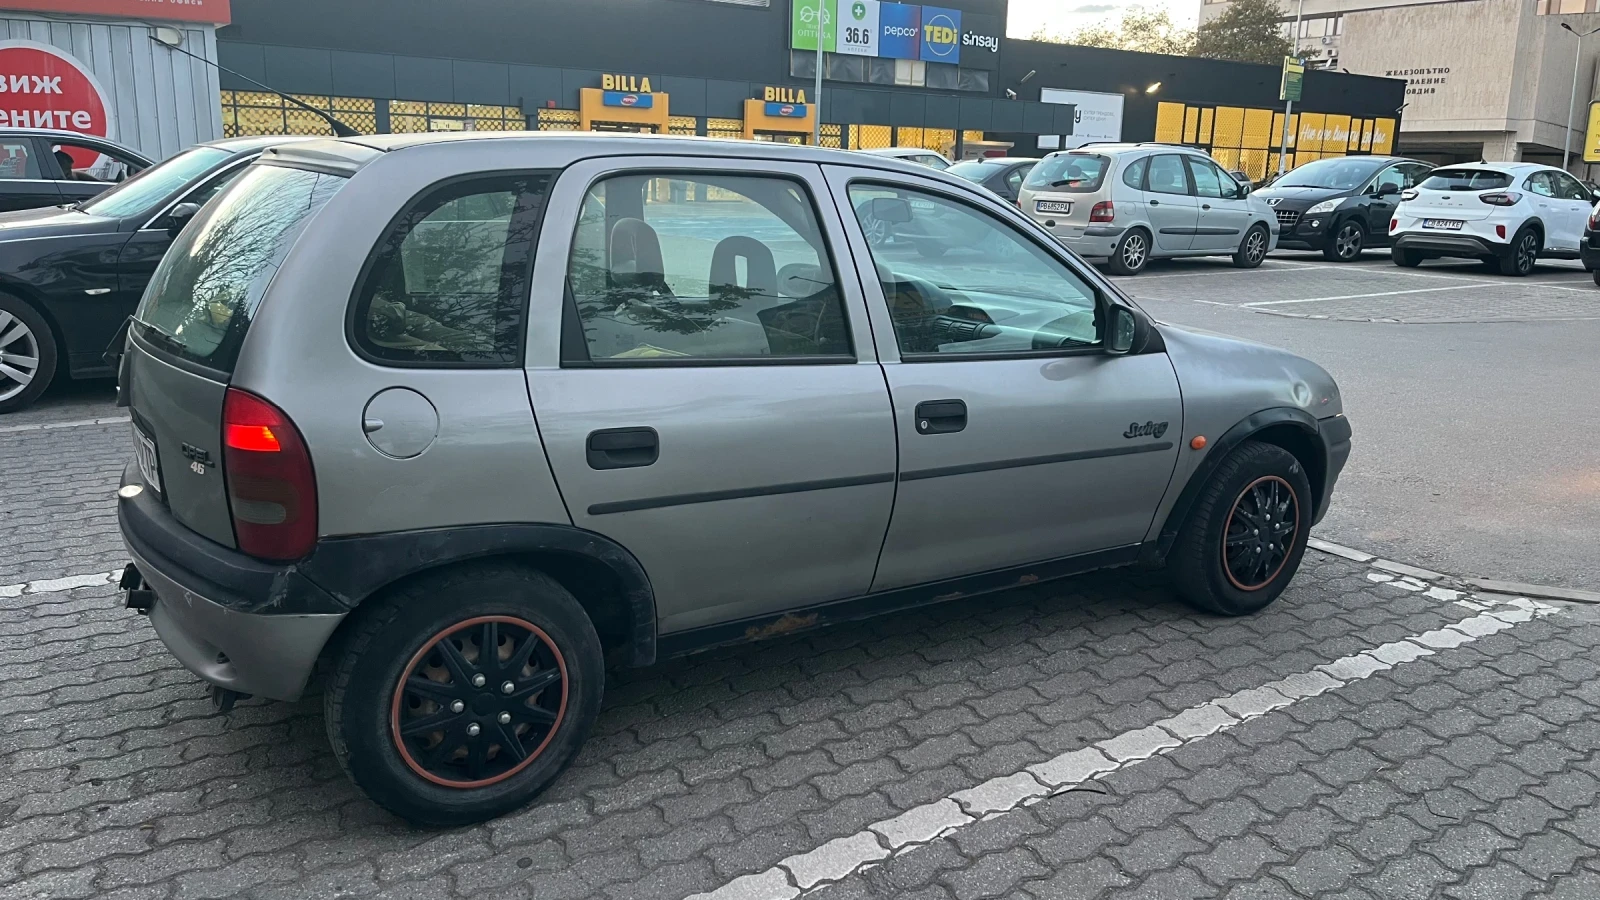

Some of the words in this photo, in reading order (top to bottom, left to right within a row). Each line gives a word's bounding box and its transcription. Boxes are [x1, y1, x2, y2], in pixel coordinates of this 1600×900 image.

[845, 27, 870, 44] 36.6
[884, 25, 917, 37] pepco
[924, 25, 958, 44] TEDi
[962, 30, 999, 53] sinsay
[1385, 67, 1450, 76] ЖЕЛЕЗОПЪТНО
[602, 73, 652, 93] BILLA
[1409, 77, 1446, 85] ВЛЕНИЕ
[764, 86, 806, 104] BILLA
[0, 109, 92, 129] ените
[190, 461, 205, 475] 46
